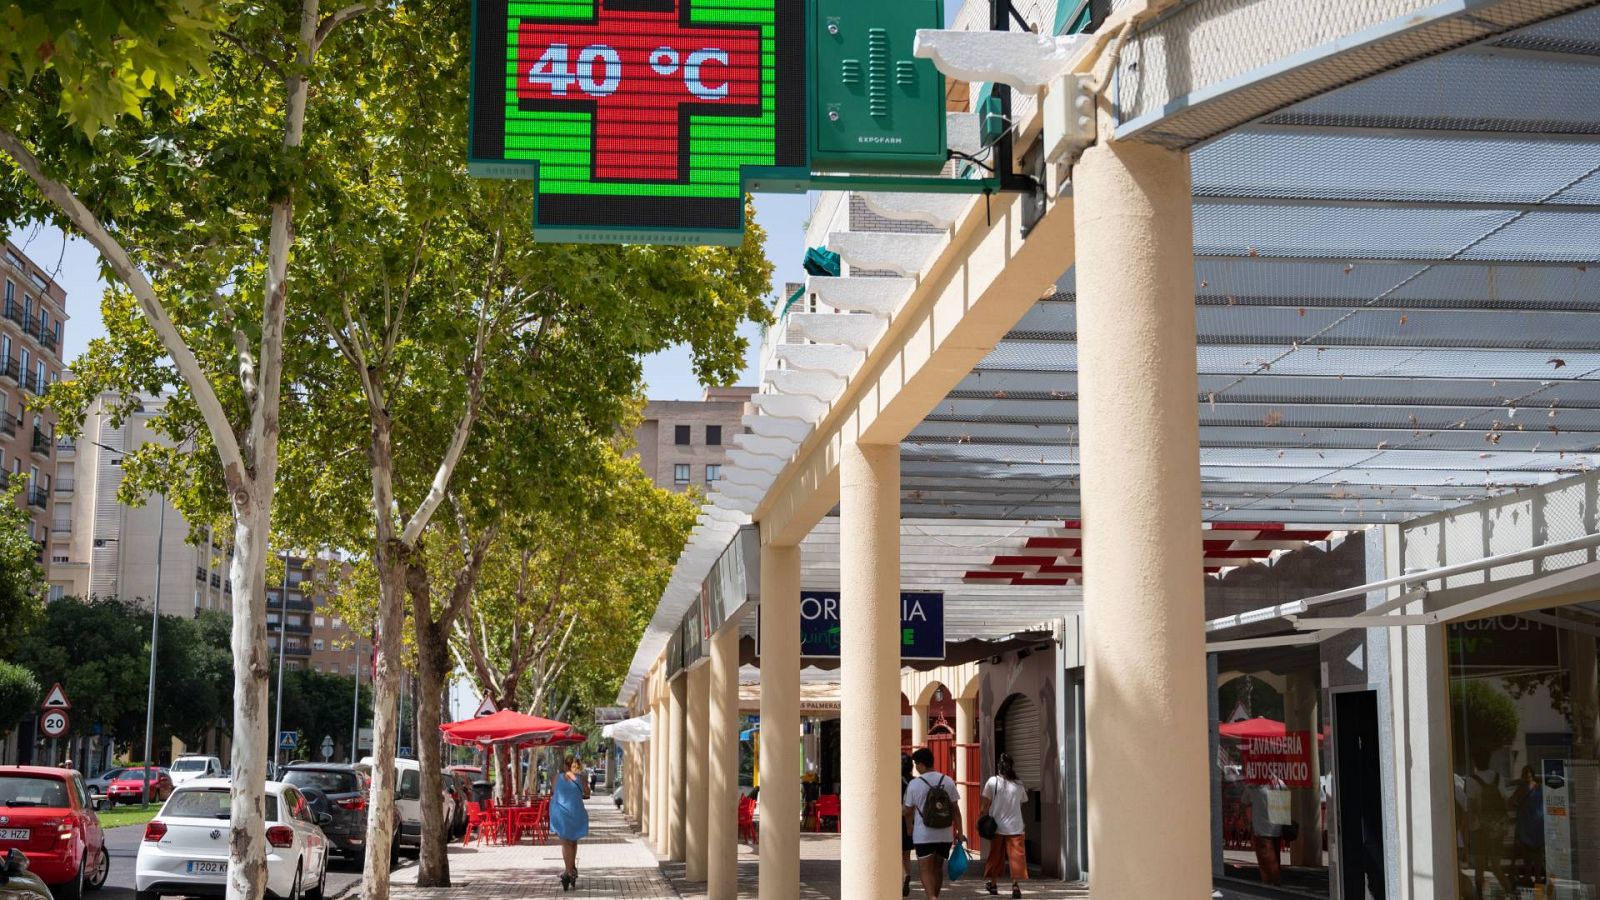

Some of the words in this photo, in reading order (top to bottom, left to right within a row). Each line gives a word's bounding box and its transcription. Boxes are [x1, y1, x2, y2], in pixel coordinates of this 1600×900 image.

[528, 43, 621, 97] 40
[858, 136, 902, 144] EXPOFARM
[46, 718, 64, 729] 20
[1249, 732, 1303, 755] LAVANDERÍA
[1246, 761, 1308, 781] AUTOSERVICIO
[11, 830, 28, 839] HZZ
[195, 862, 217, 872] 1202
